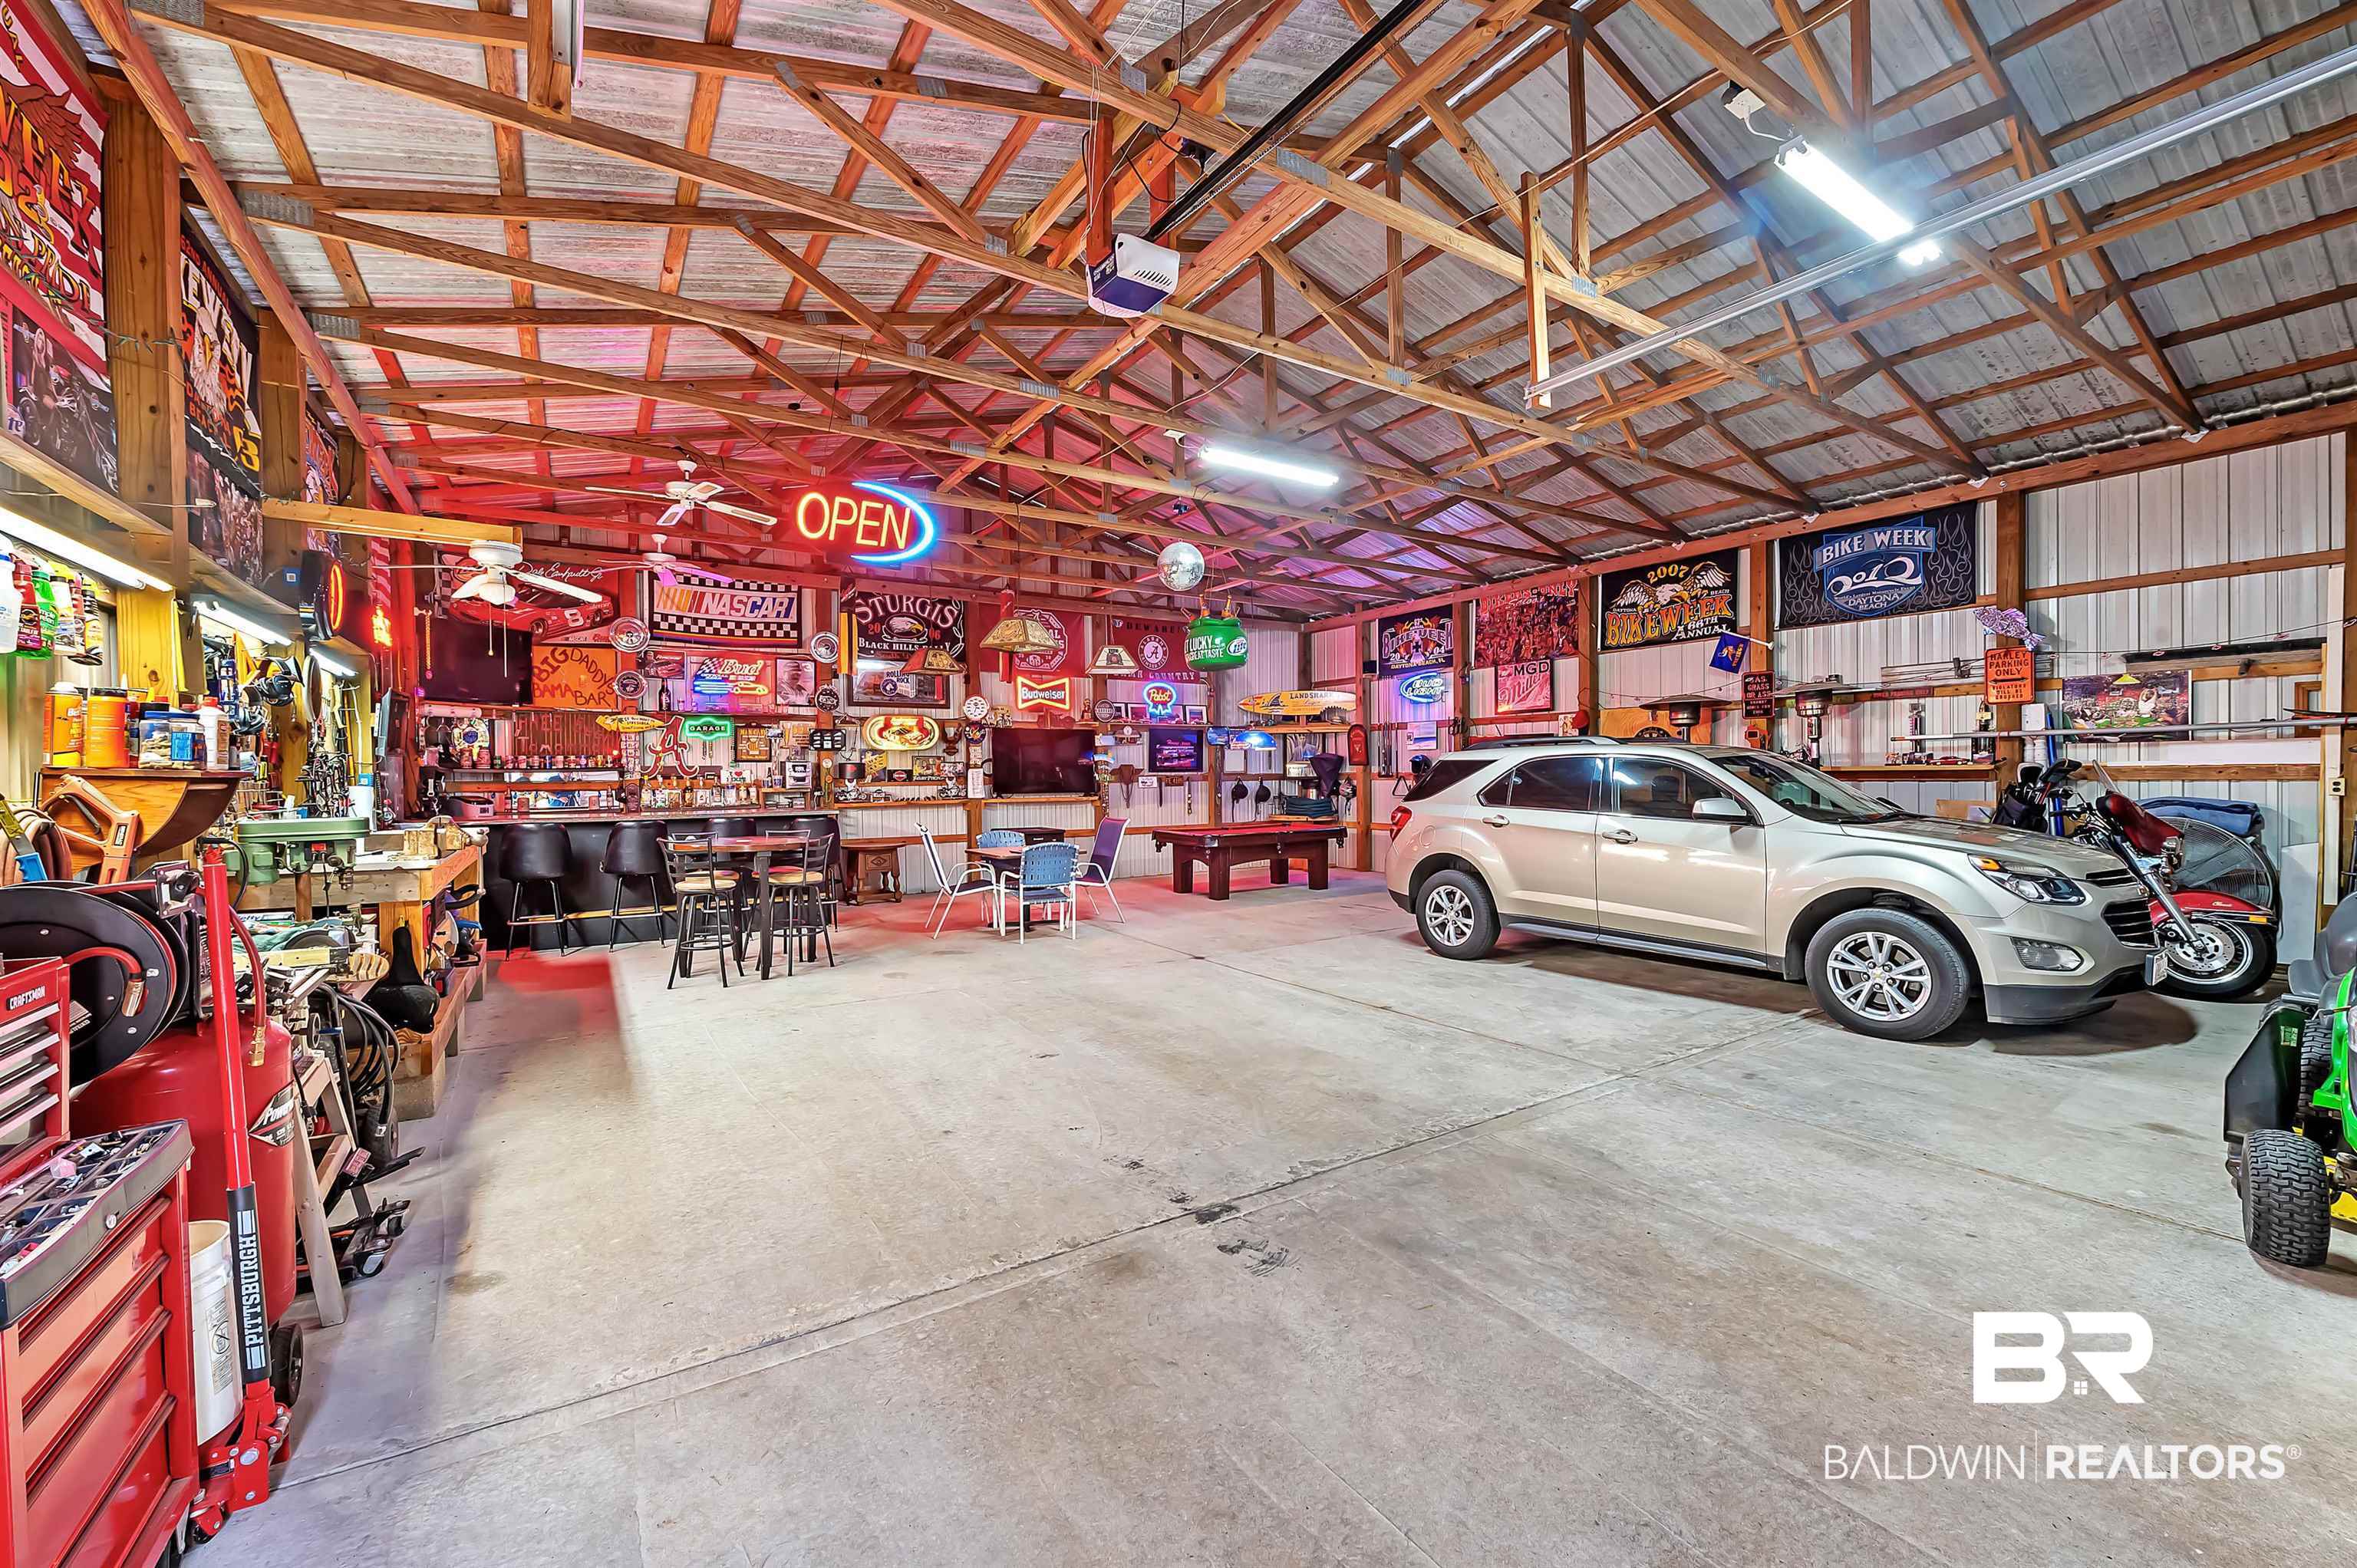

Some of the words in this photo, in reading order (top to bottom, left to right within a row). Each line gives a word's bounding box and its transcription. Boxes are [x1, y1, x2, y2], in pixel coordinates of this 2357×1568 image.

[797, 492, 911, 549] OPEN
[1822, 535, 1864, 564] BIKE
[1873, 530, 1929, 548] WEEK
[1647, 564, 1689, 583] 2007
[701, 592, 790, 618] NASCAR
[1848, 593, 1900, 606] DAYTONA
[1859, 602, 1887, 611] BEACH
[564, 609, 585, 627] 8
[855, 593, 958, 628] STURGIS
[1606, 611, 1661, 646] BIKE
[1660, 595, 1734, 634] WEEK
[859, 637, 889, 649] BLACK
[1189, 634, 1213, 651] LUCKY
[1203, 648, 1224, 658] TASTE
[1990, 651, 2026, 660] HARLEY
[532, 647, 569, 683] BIG
[718, 659, 764, 675] Bud
[1514, 661, 1550, 677] MGD
[1989, 659, 2029, 669] PARKING
[1995, 667, 2022, 677] ONLY
[534, 683, 576, 698] BAMA
[574, 690, 613, 707] BAR
[1022, 687, 1065, 700] Budweiser
[1149, 689, 1171, 702] Pabst
[10, 986, 46, 1010] CRAFTSMAN
[239, 1235, 265, 1347] PITTSBURGH
